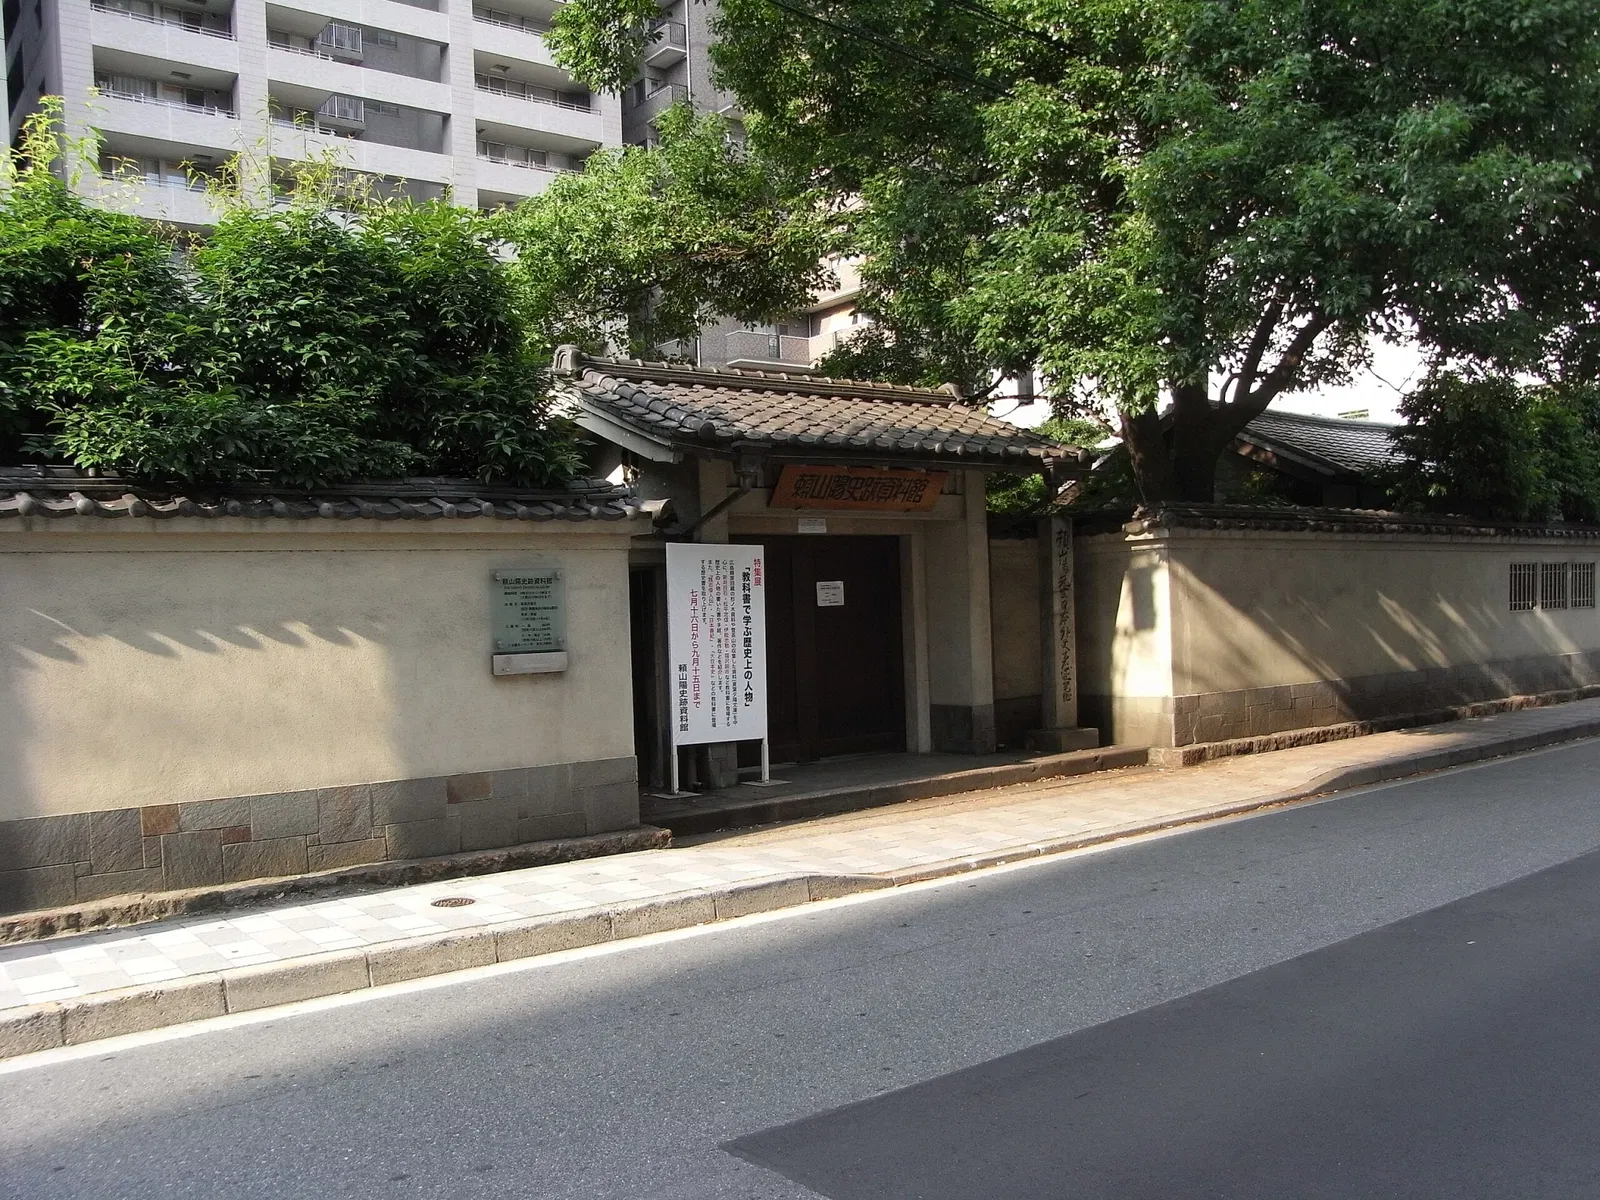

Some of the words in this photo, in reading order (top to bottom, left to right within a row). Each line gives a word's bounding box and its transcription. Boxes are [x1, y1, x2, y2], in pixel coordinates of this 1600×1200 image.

[792, 473, 930, 504] 頼山陽史跡資料館
[753, 558, 762, 587] 特集展
[689, 589, 700, 709] 七月十六日から九月十五日まで
[742, 566, 753, 708] 「教科書で学ぶ歴史上の人物」
[678, 663, 689, 733] 頼山陽史跡資料館
